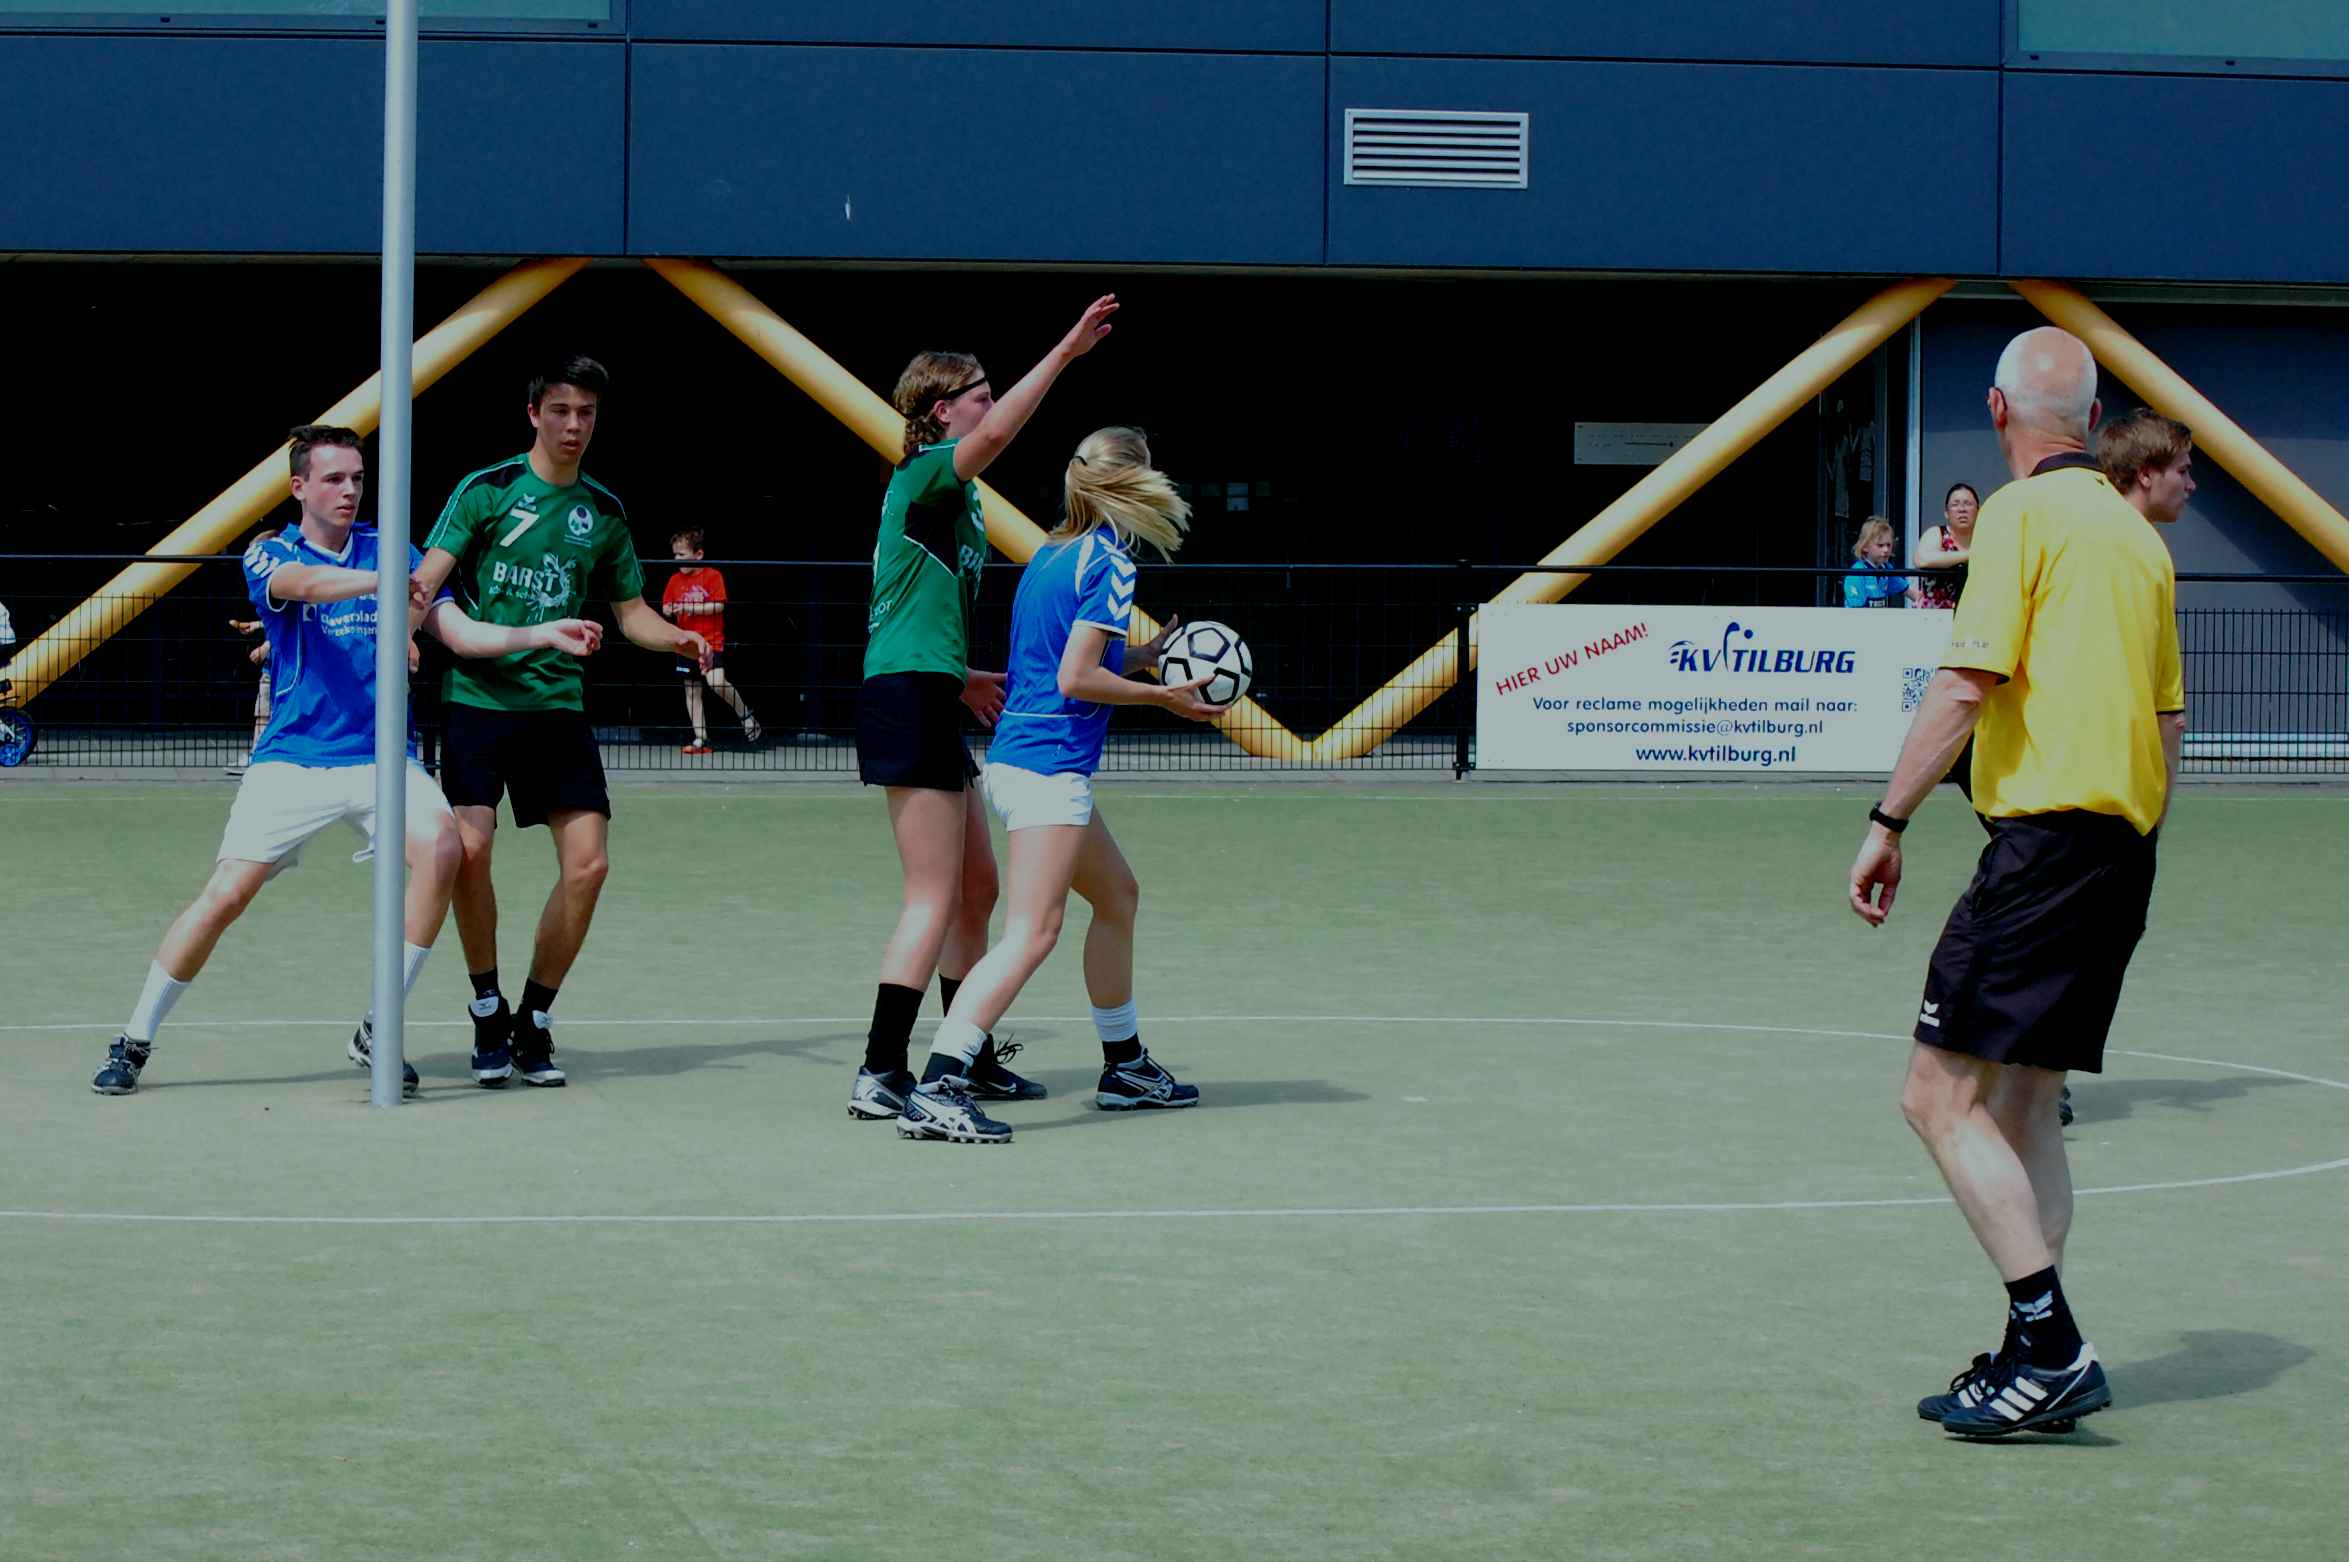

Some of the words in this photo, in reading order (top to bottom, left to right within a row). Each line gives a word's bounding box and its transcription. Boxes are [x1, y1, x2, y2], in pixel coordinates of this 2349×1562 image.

[499, 507, 540, 548] 7
[492, 561, 560, 592] BARST
[1495, 667, 1542, 695] HIER
[1545, 650, 1579, 676] UW
[1584, 622, 1649, 660] NAAM!
[1732, 649, 1856, 673] TILBURG
[1532, 697, 1569, 711] Voor
[1576, 697, 1642, 711] reclame
[1648, 697, 1768, 715] mogelijkheden
[1775, 698, 1810, 712] mail
[1816, 700, 1858, 712] naar:
[1567, 719, 1824, 737] sponsorcommissie@kvtilburg.nl
[1636, 745, 1796, 767] www.kvtilburg.nl
